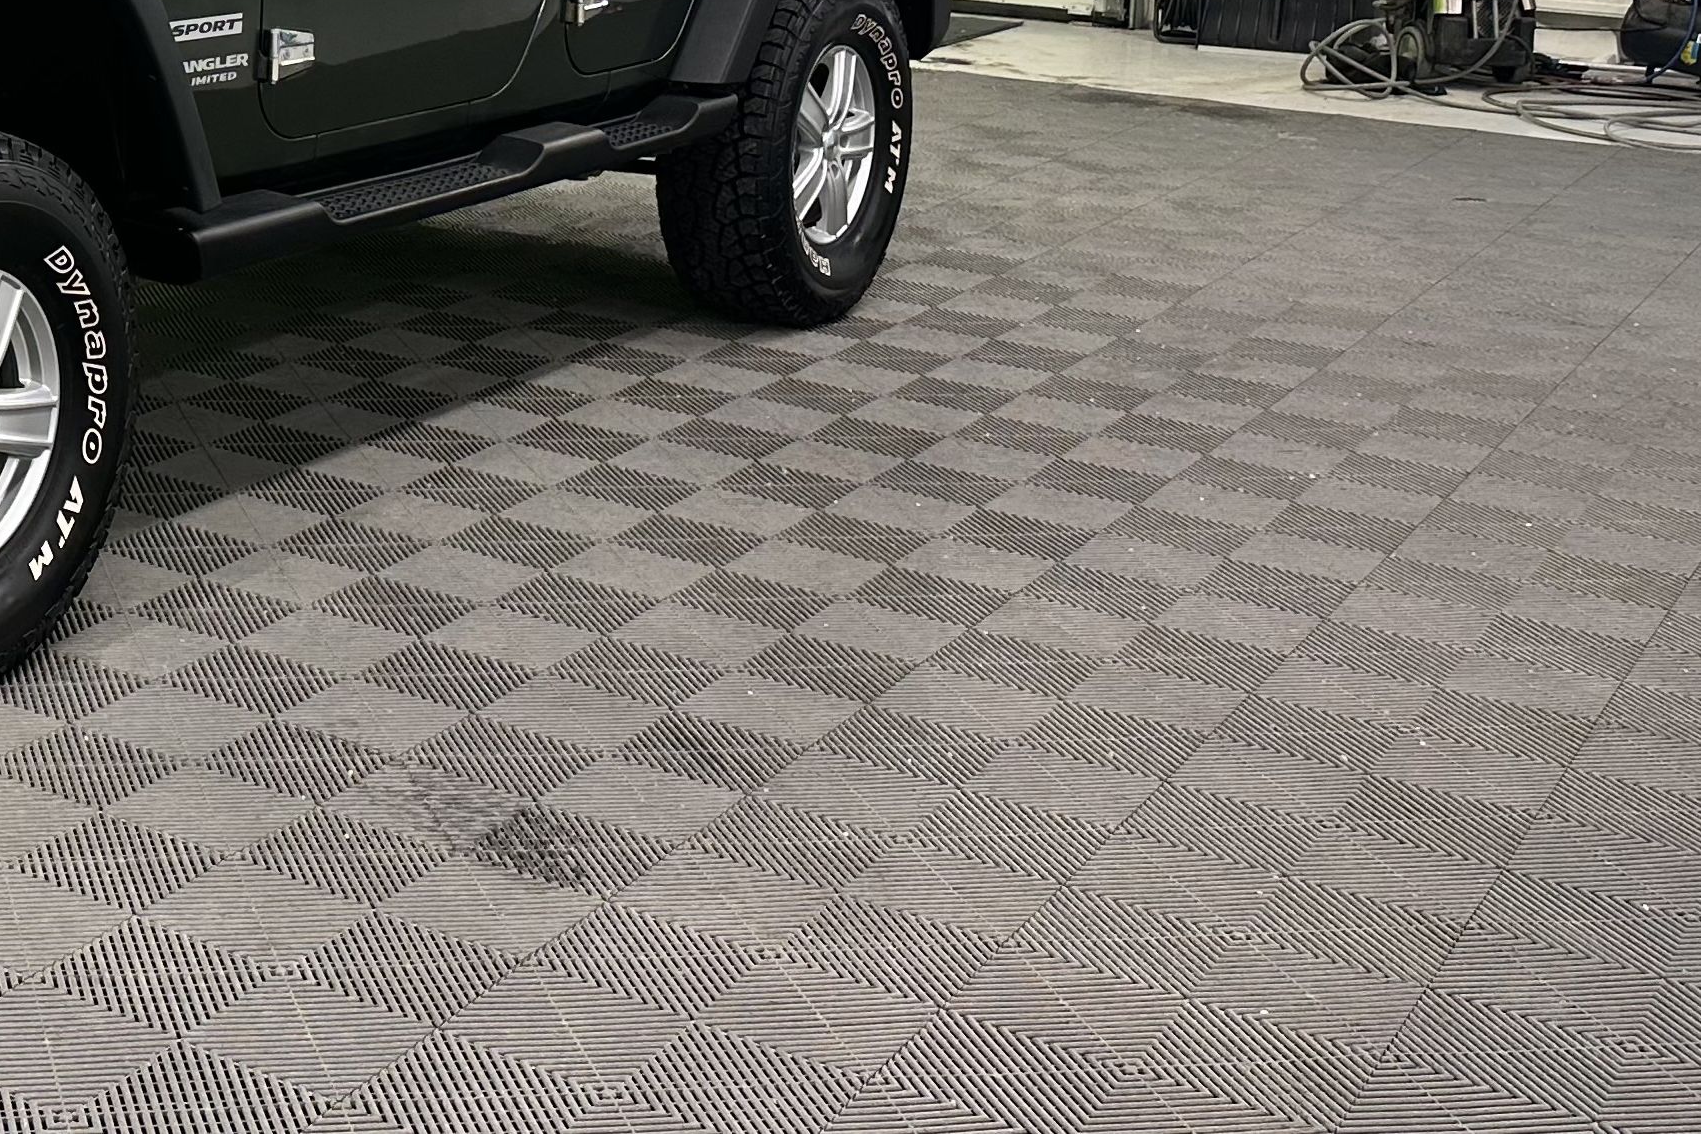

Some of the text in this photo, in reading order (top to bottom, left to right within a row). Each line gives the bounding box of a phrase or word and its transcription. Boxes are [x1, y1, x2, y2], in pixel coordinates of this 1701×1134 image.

[172, 19, 243, 37] SPORT
[191, 71, 237, 87] IMITED
[44, 245, 108, 465] Dynapro
